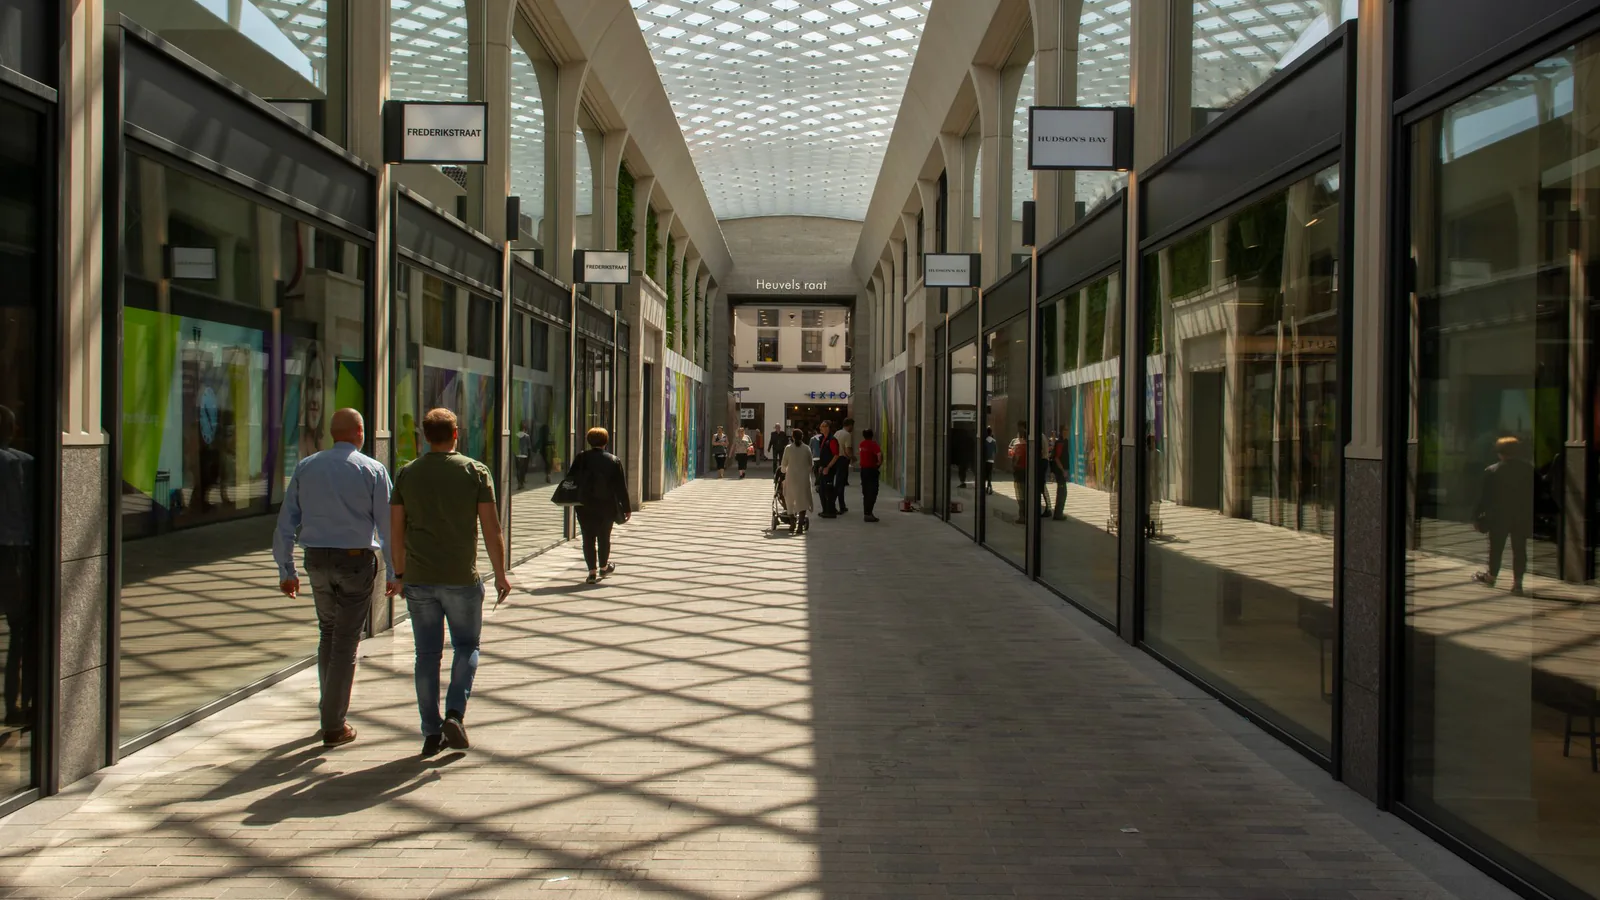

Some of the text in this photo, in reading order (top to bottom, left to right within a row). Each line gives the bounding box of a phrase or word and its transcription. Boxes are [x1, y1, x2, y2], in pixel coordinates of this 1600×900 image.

[407, 128, 482, 137] FREDERIKSTRAAT
[1037, 135, 1087, 143] HUDSON'S
[810, 391, 848, 399] EXPO
